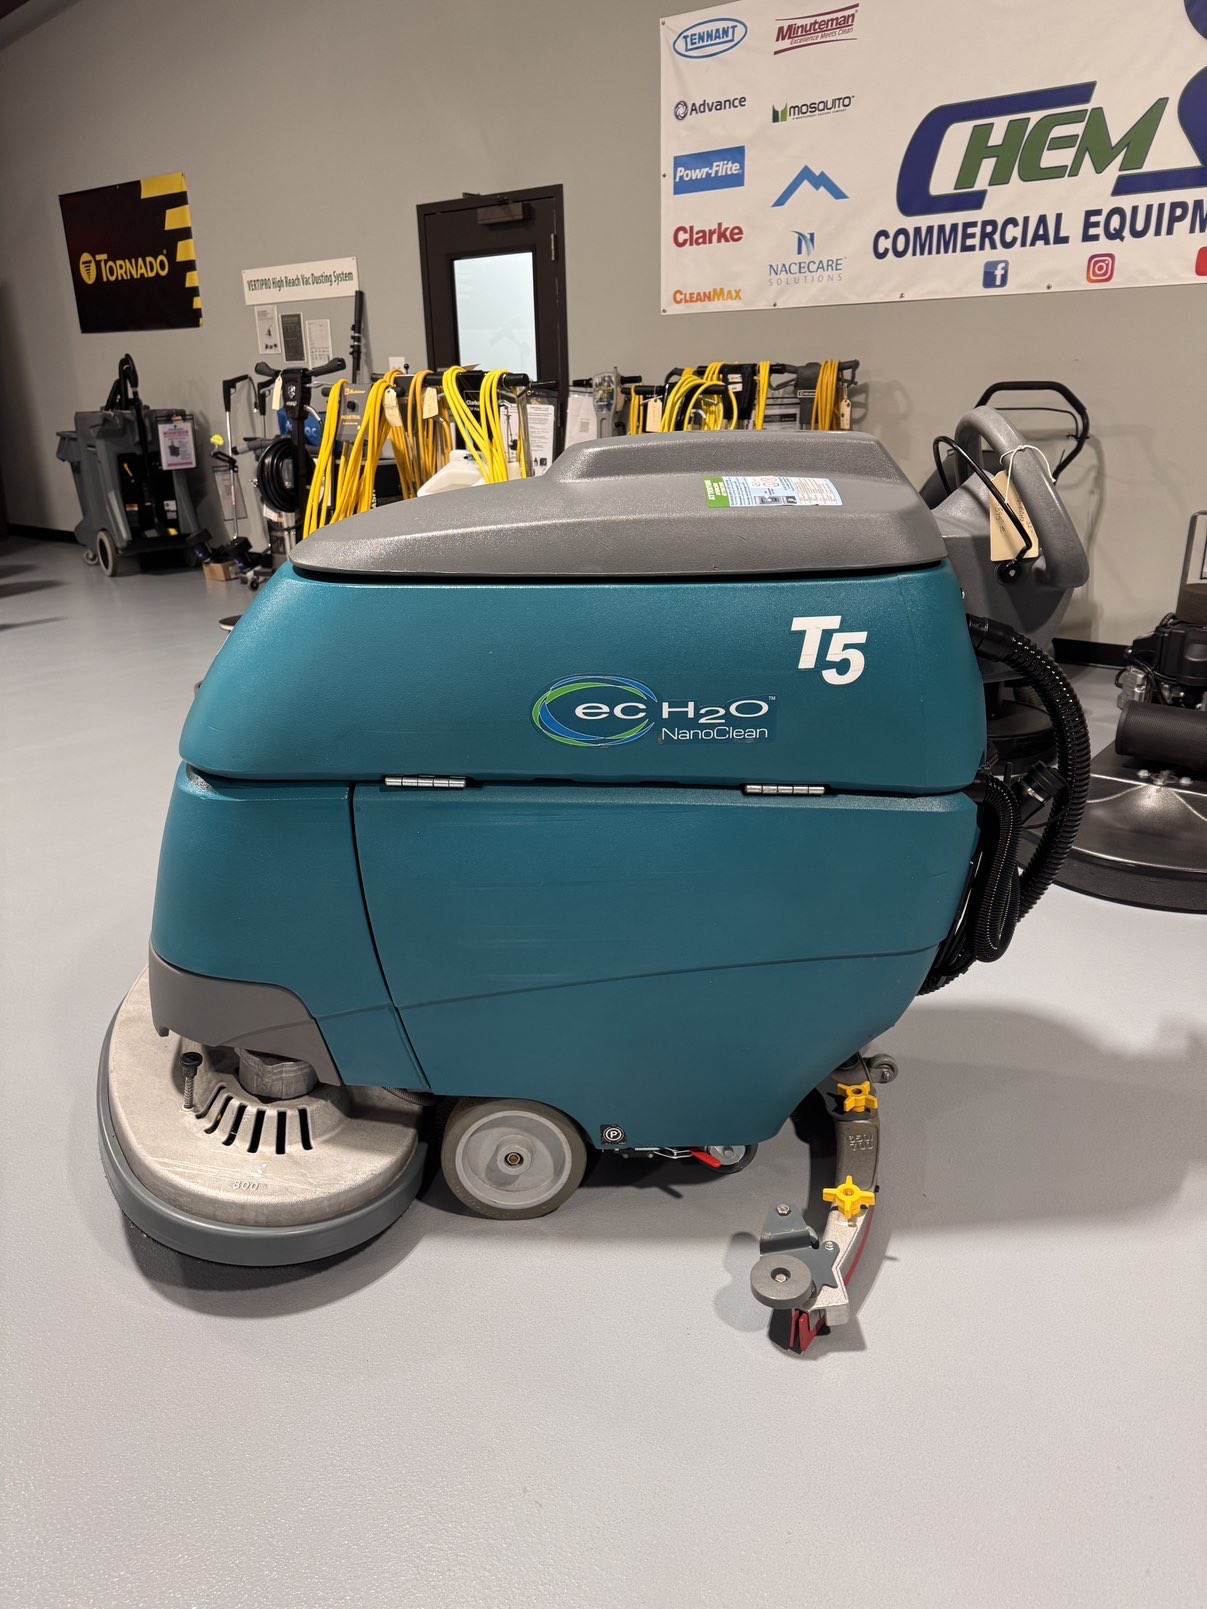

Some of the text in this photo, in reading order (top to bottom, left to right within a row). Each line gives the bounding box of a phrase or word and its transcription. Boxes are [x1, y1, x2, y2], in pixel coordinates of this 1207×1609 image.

[775, 12, 856, 42] Minuteman
[790, 27, 854, 45] Excellence Meets Clean
[683, 25, 738, 51] TENNANT
[690, 96, 746, 116] Advance
[675, 161, 740, 182] Powr-Flite
[673, 222, 743, 248] Clarke
[872, 213, 1070, 260] COMMERCIAL
[95, 253, 169, 282] TORNADO
[769, 258, 843, 276] NACECARE
[272, 276, 285, 291] High
[285, 275, 301, 289] Reach
[301, 274, 311, 286] Vac
[311, 272, 333, 286] Dusting
[333, 270, 354, 285] System
[769, 273, 843, 287] SOLUTIONS
[791, 616, 868, 686] T5
[661, 726, 768, 741] NanoClean
